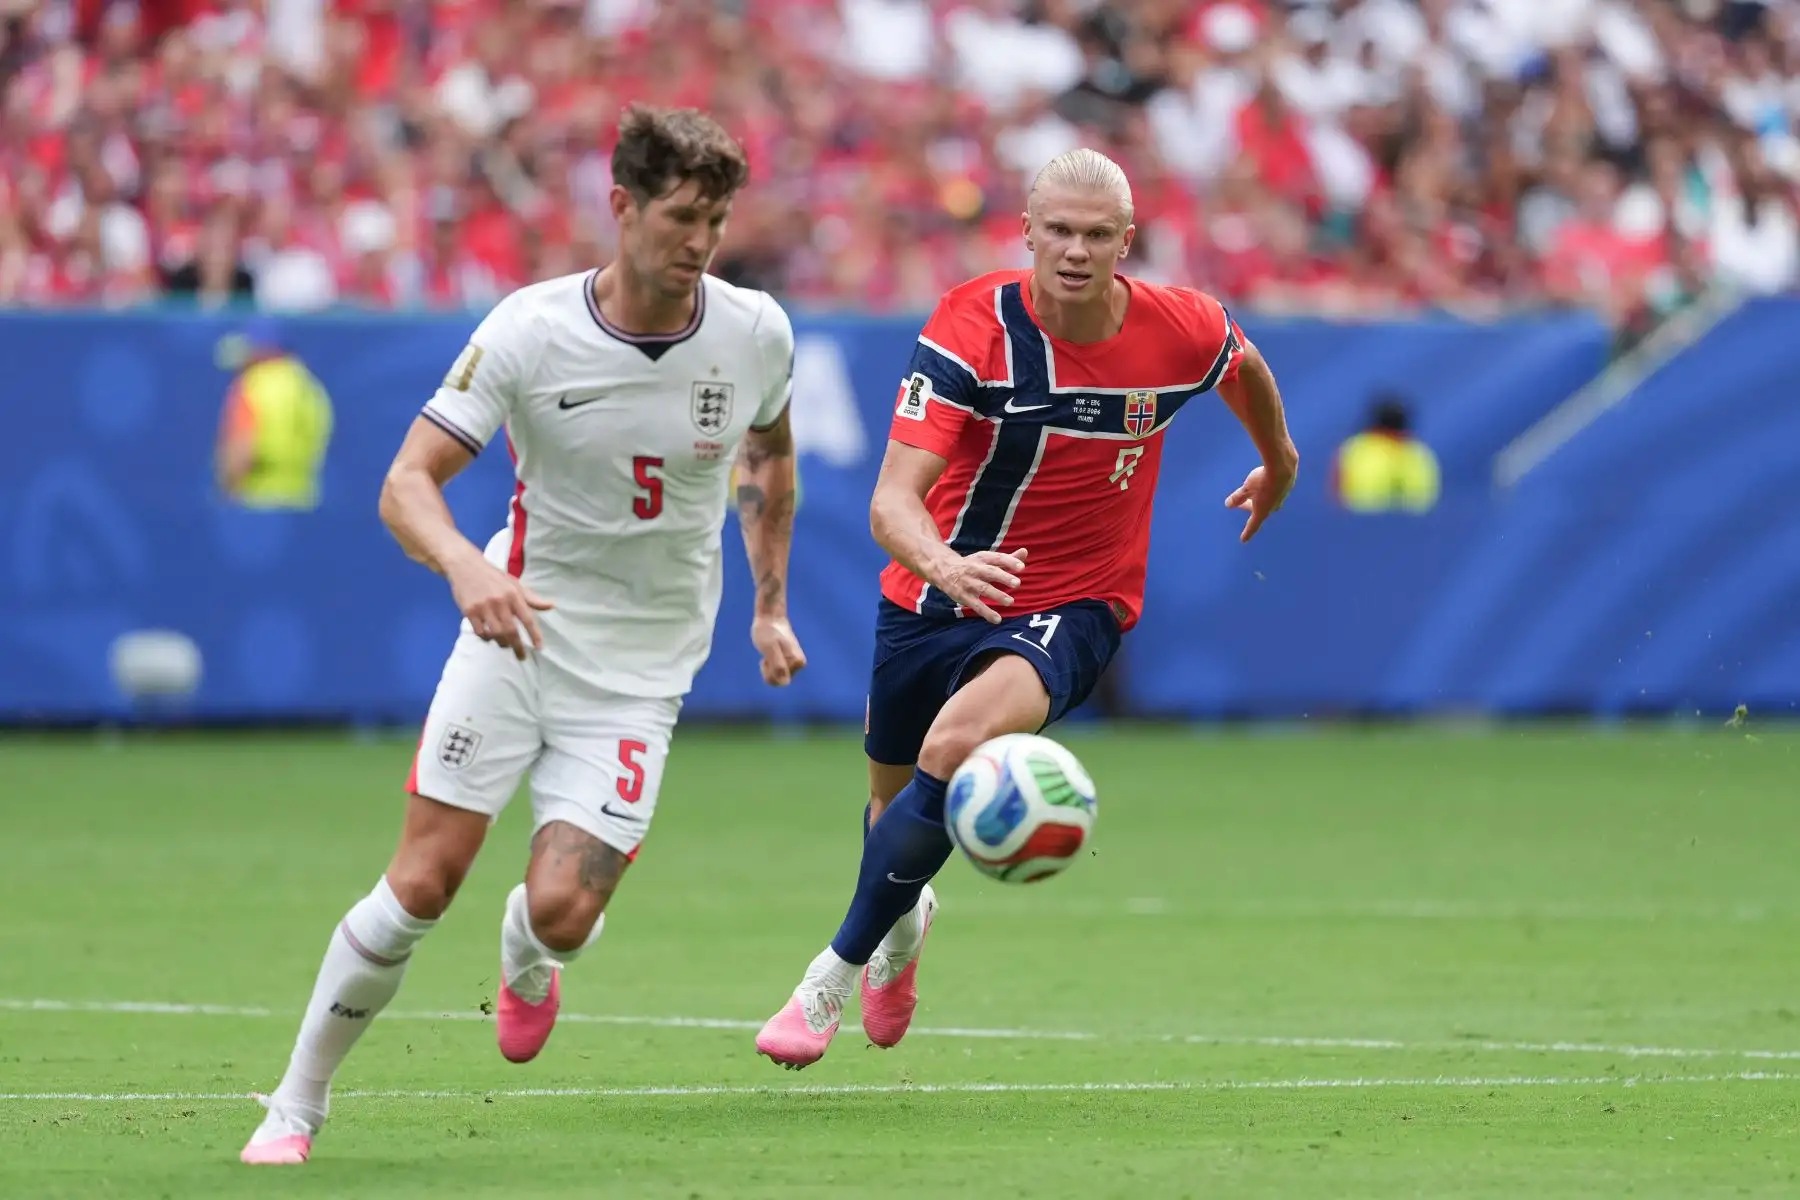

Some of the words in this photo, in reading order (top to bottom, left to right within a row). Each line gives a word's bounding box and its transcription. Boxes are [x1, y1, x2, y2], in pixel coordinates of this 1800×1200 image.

[903, 408, 919, 416] 2026
[633, 456, 664, 520] 5
[616, 739, 647, 804] 5
